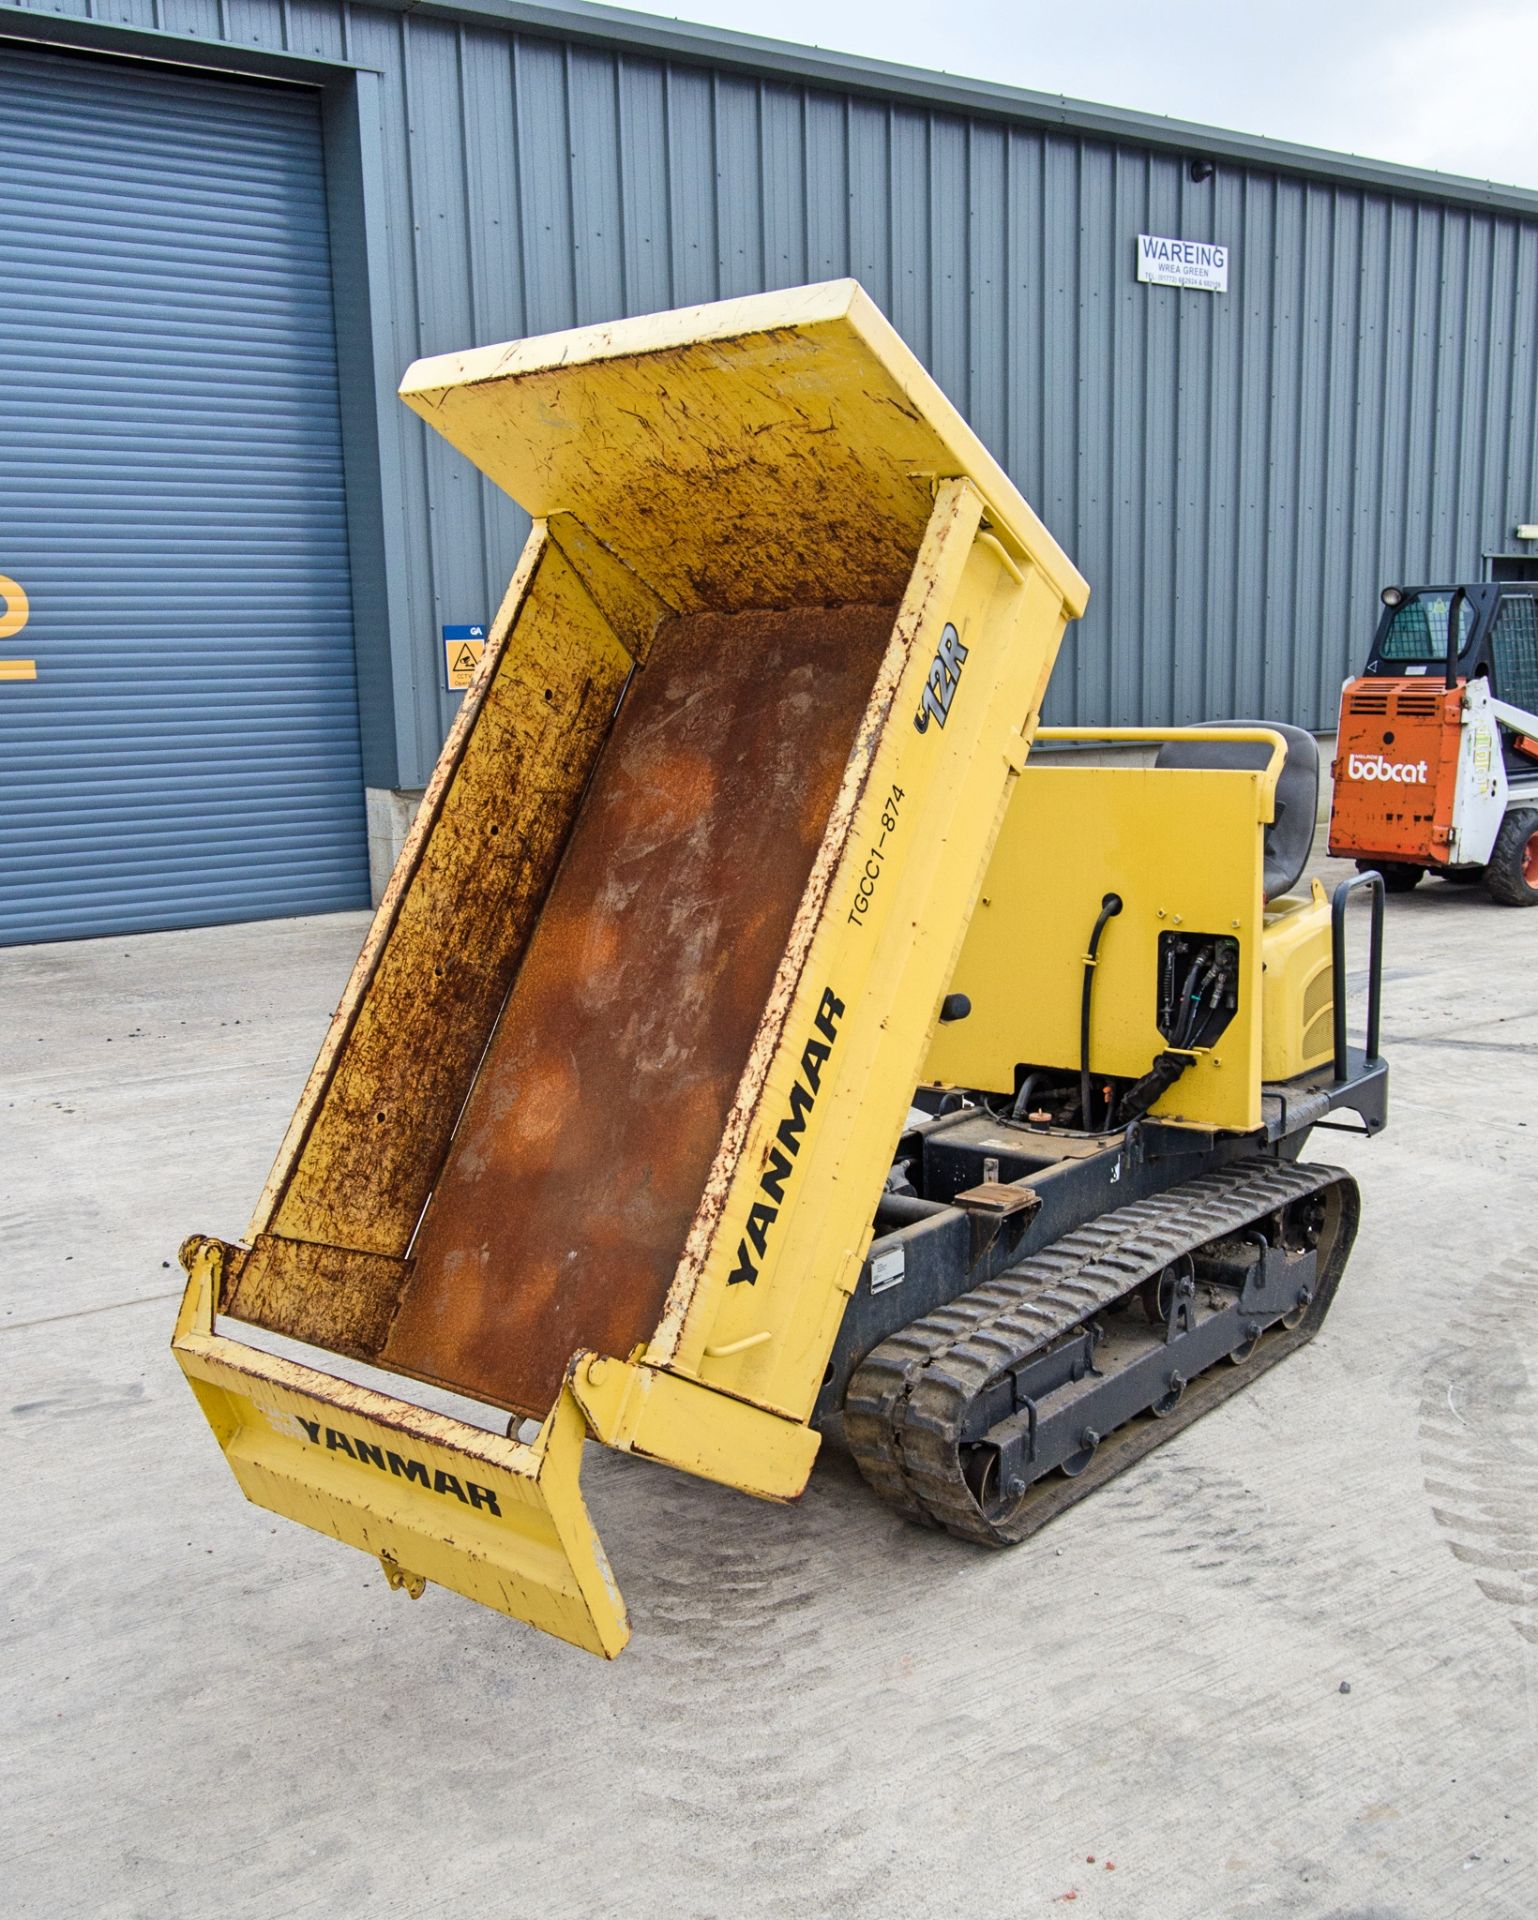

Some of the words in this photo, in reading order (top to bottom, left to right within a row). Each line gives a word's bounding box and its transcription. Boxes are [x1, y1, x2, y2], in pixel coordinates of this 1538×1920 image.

[1143, 237, 1224, 268] WAREING
[1158, 263, 1181, 274] WREA
[1183, 266, 1209, 277] GREEN
[470, 627, 482, 635] GA
[1348, 754, 1428, 784] bobcat
[847, 784, 905, 926] TGCC1-874
[727, 986, 846, 1286] YANMAR
[295, 1415, 502, 1518] YANMAR
